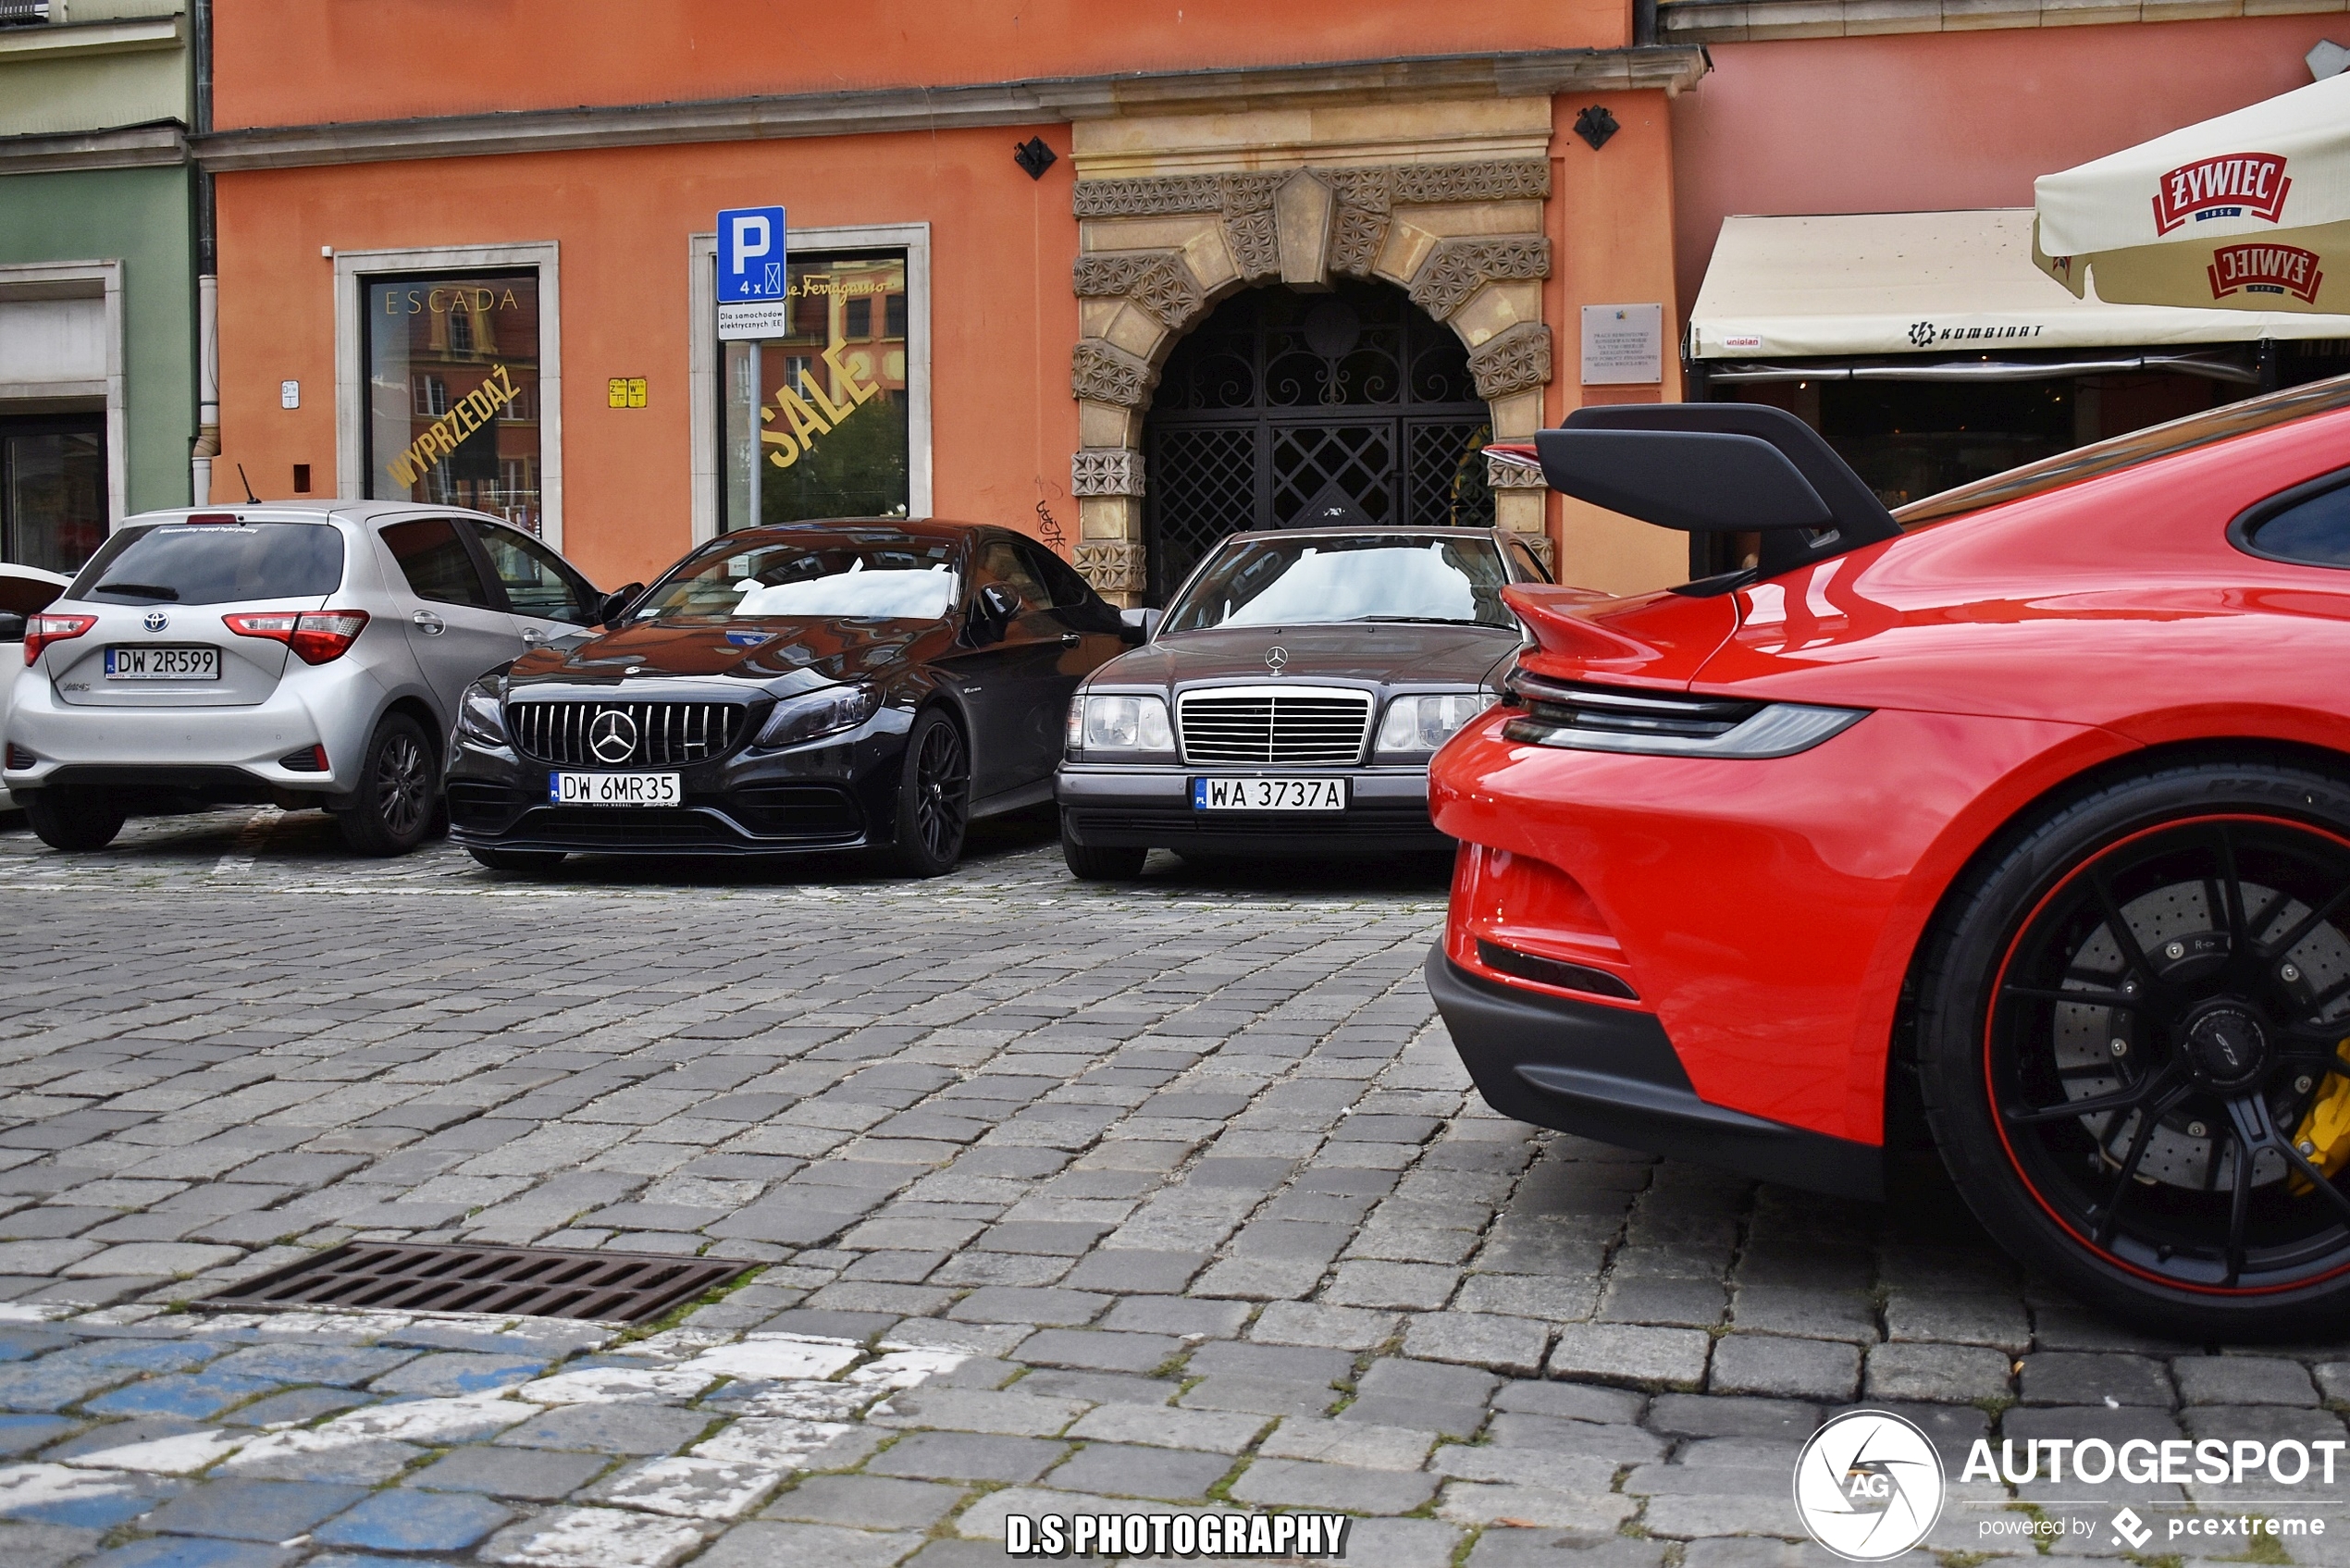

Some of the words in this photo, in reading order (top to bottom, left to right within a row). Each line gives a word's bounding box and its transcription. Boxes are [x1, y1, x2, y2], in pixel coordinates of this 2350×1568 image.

[2171, 159, 2276, 211] ŻYWIEC
[2205, 208, 2232, 218] 1856
[733, 216, 771, 275] P
[740, 280, 749, 294] 4
[386, 289, 519, 315] ESCADA
[720, 321, 769, 330] elektrycznych
[735, 311, 783, 319] samochodów
[1940, 326, 2043, 340] KOMBINAT
[761, 337, 881, 468] SALE
[386, 364, 521, 490] WYPRZEDAŻ
[118, 651, 145, 673] DW
[153, 651, 214, 673] 2R599
[563, 776, 590, 799] DW
[600, 777, 674, 800] 6MR35
[1211, 781, 1246, 807] WA
[1258, 781, 1340, 807] 3737A
